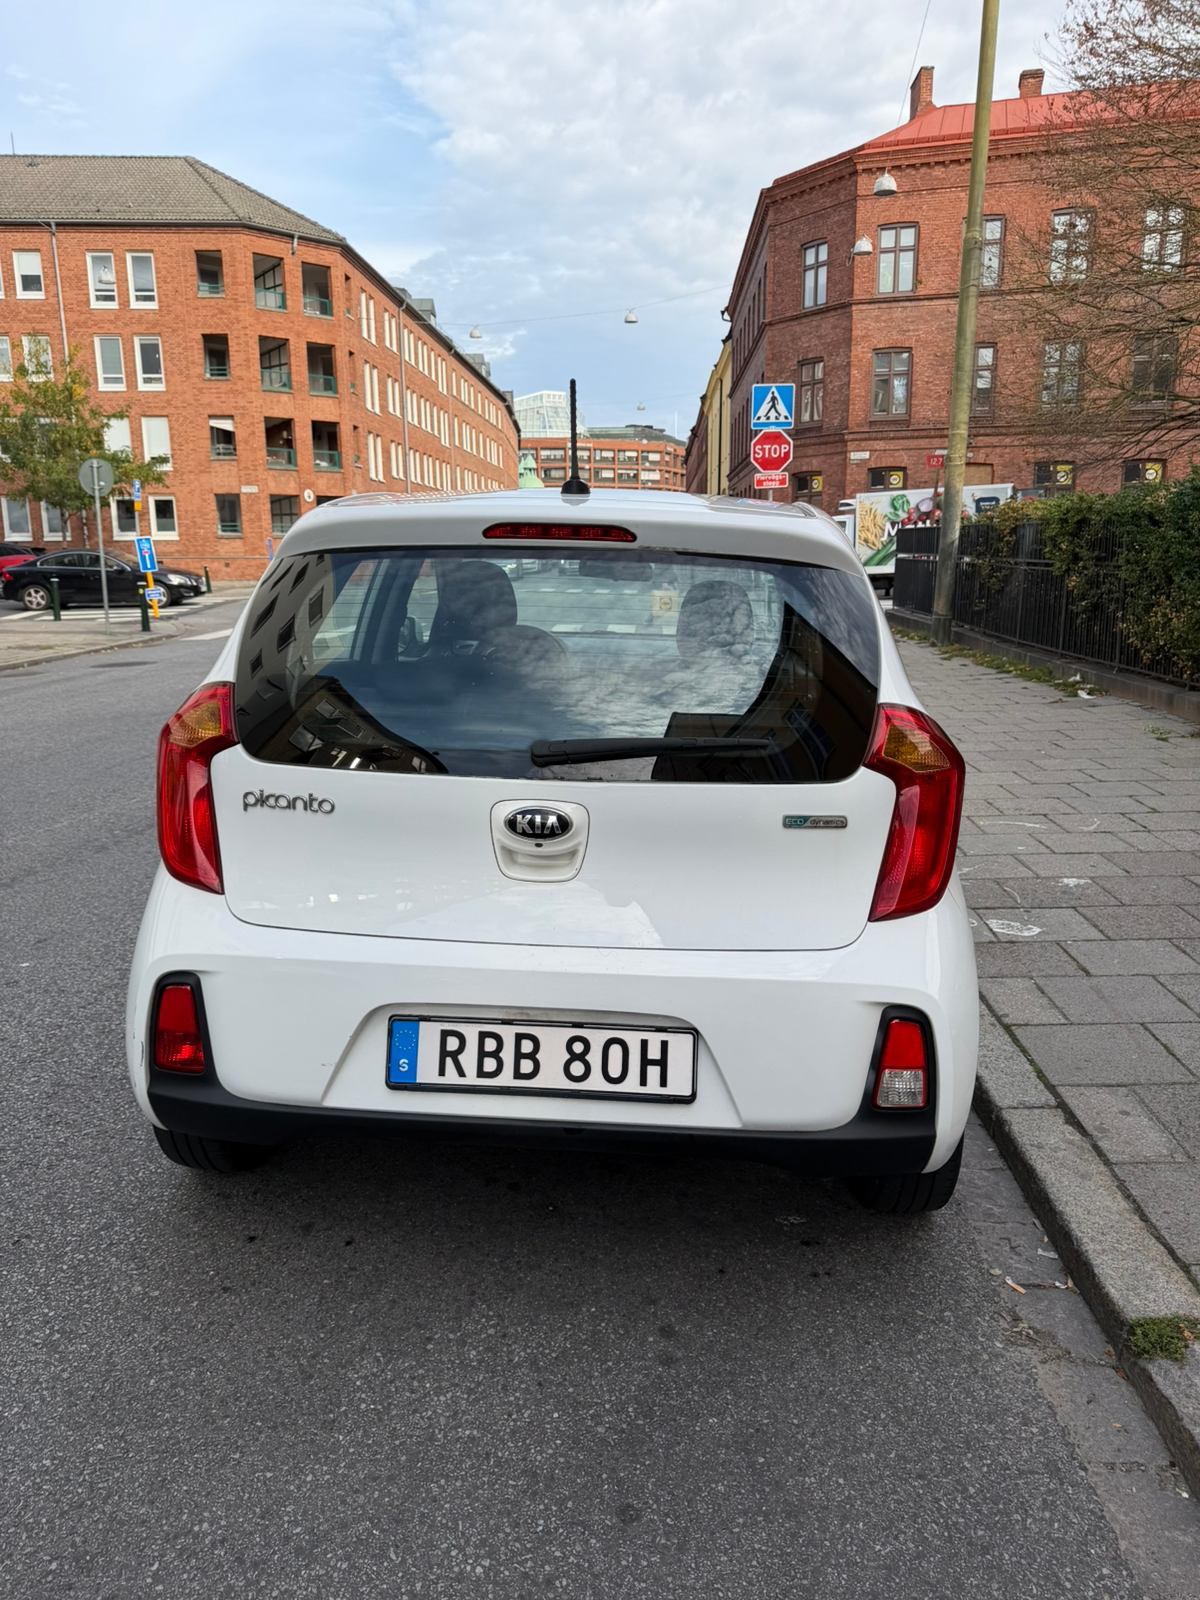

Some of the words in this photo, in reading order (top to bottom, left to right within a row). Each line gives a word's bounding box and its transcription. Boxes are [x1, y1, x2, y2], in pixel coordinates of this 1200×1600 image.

[754, 444, 790, 459] STOP
[242, 788, 335, 814] picanto
[516, 814, 562, 834] KIA
[809, 818, 845, 827] dynamics
[398, 1058, 409, 1073] S
[438, 1029, 541, 1079] RBB
[563, 1035, 669, 1088] 80H
